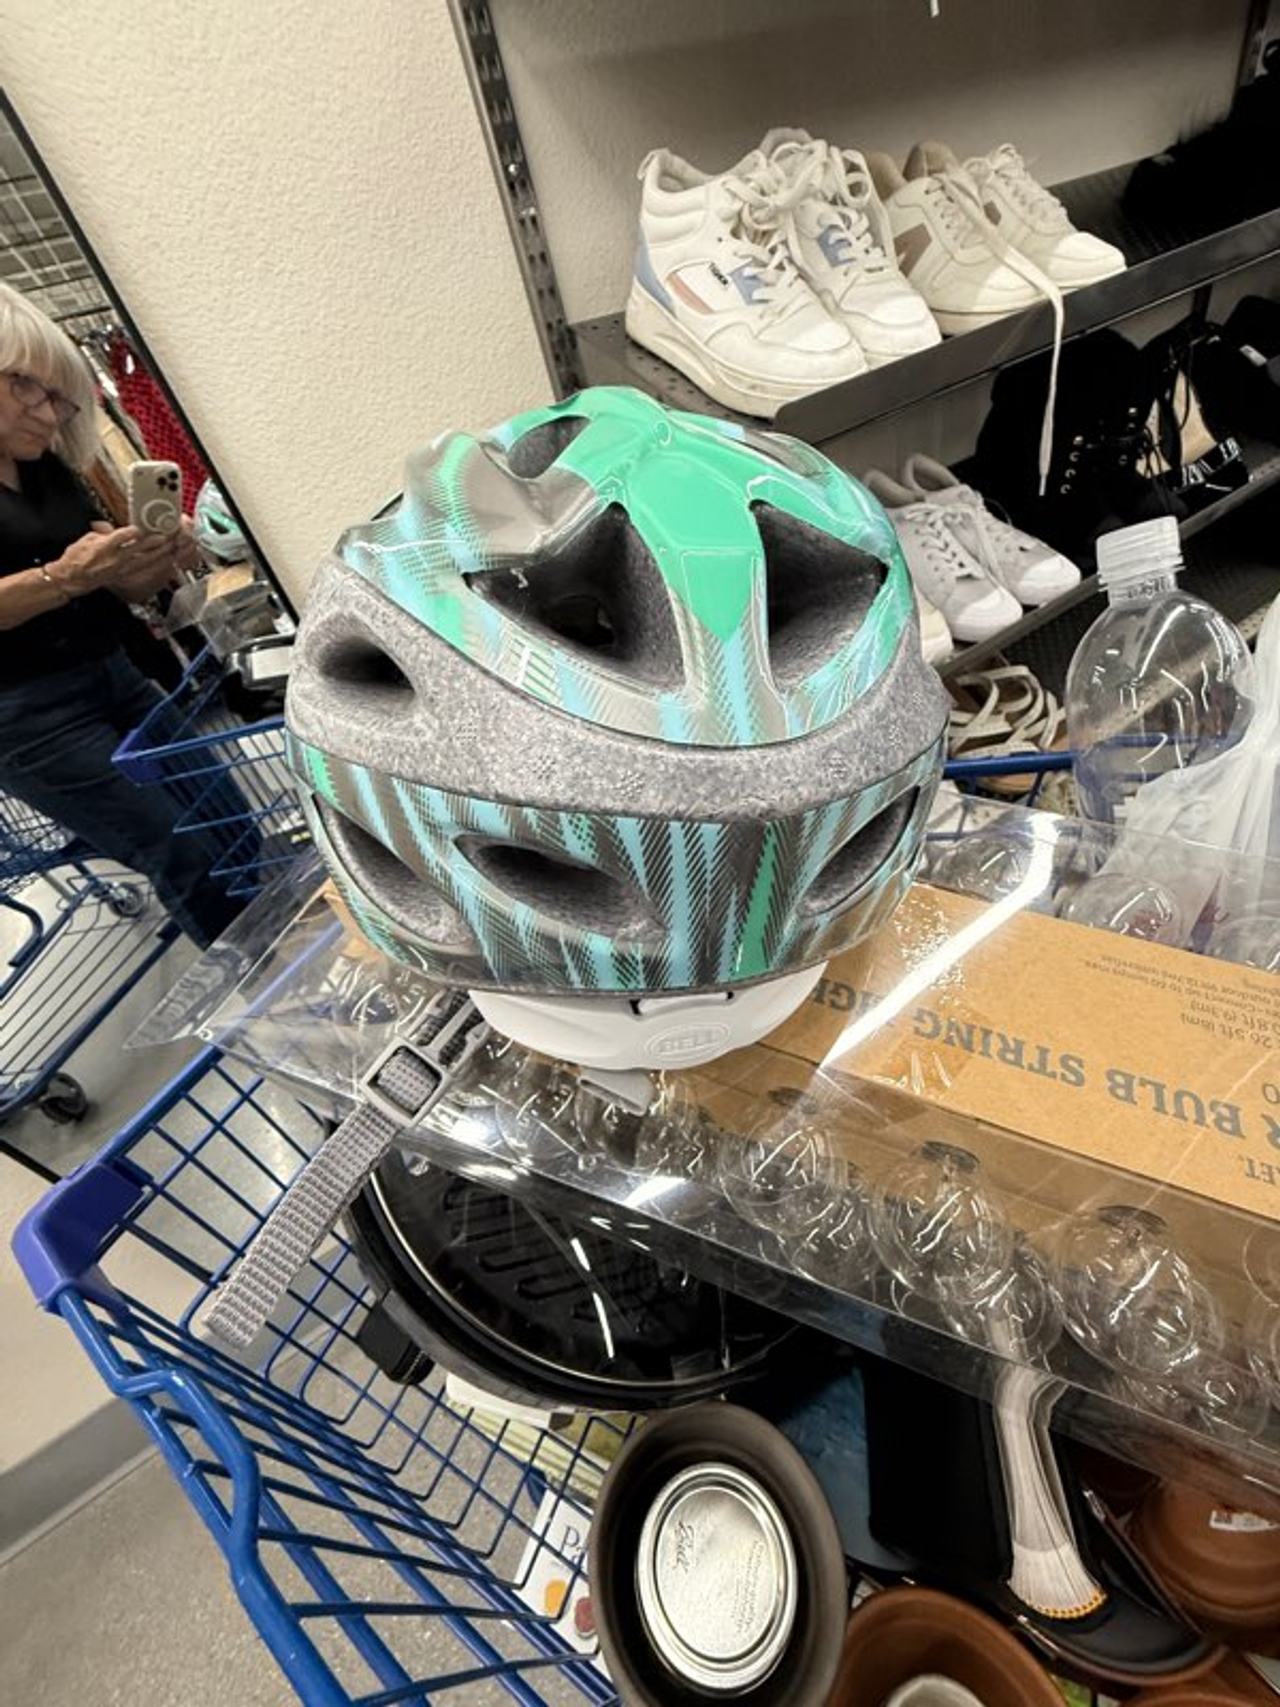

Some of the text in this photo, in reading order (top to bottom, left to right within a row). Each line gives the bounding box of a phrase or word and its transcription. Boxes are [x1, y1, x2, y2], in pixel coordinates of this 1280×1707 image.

[658, 1027, 720, 1054] BELL
[912, 1005, 1086, 1088] STRING
[1104, 1067, 1246, 1140] BULB
